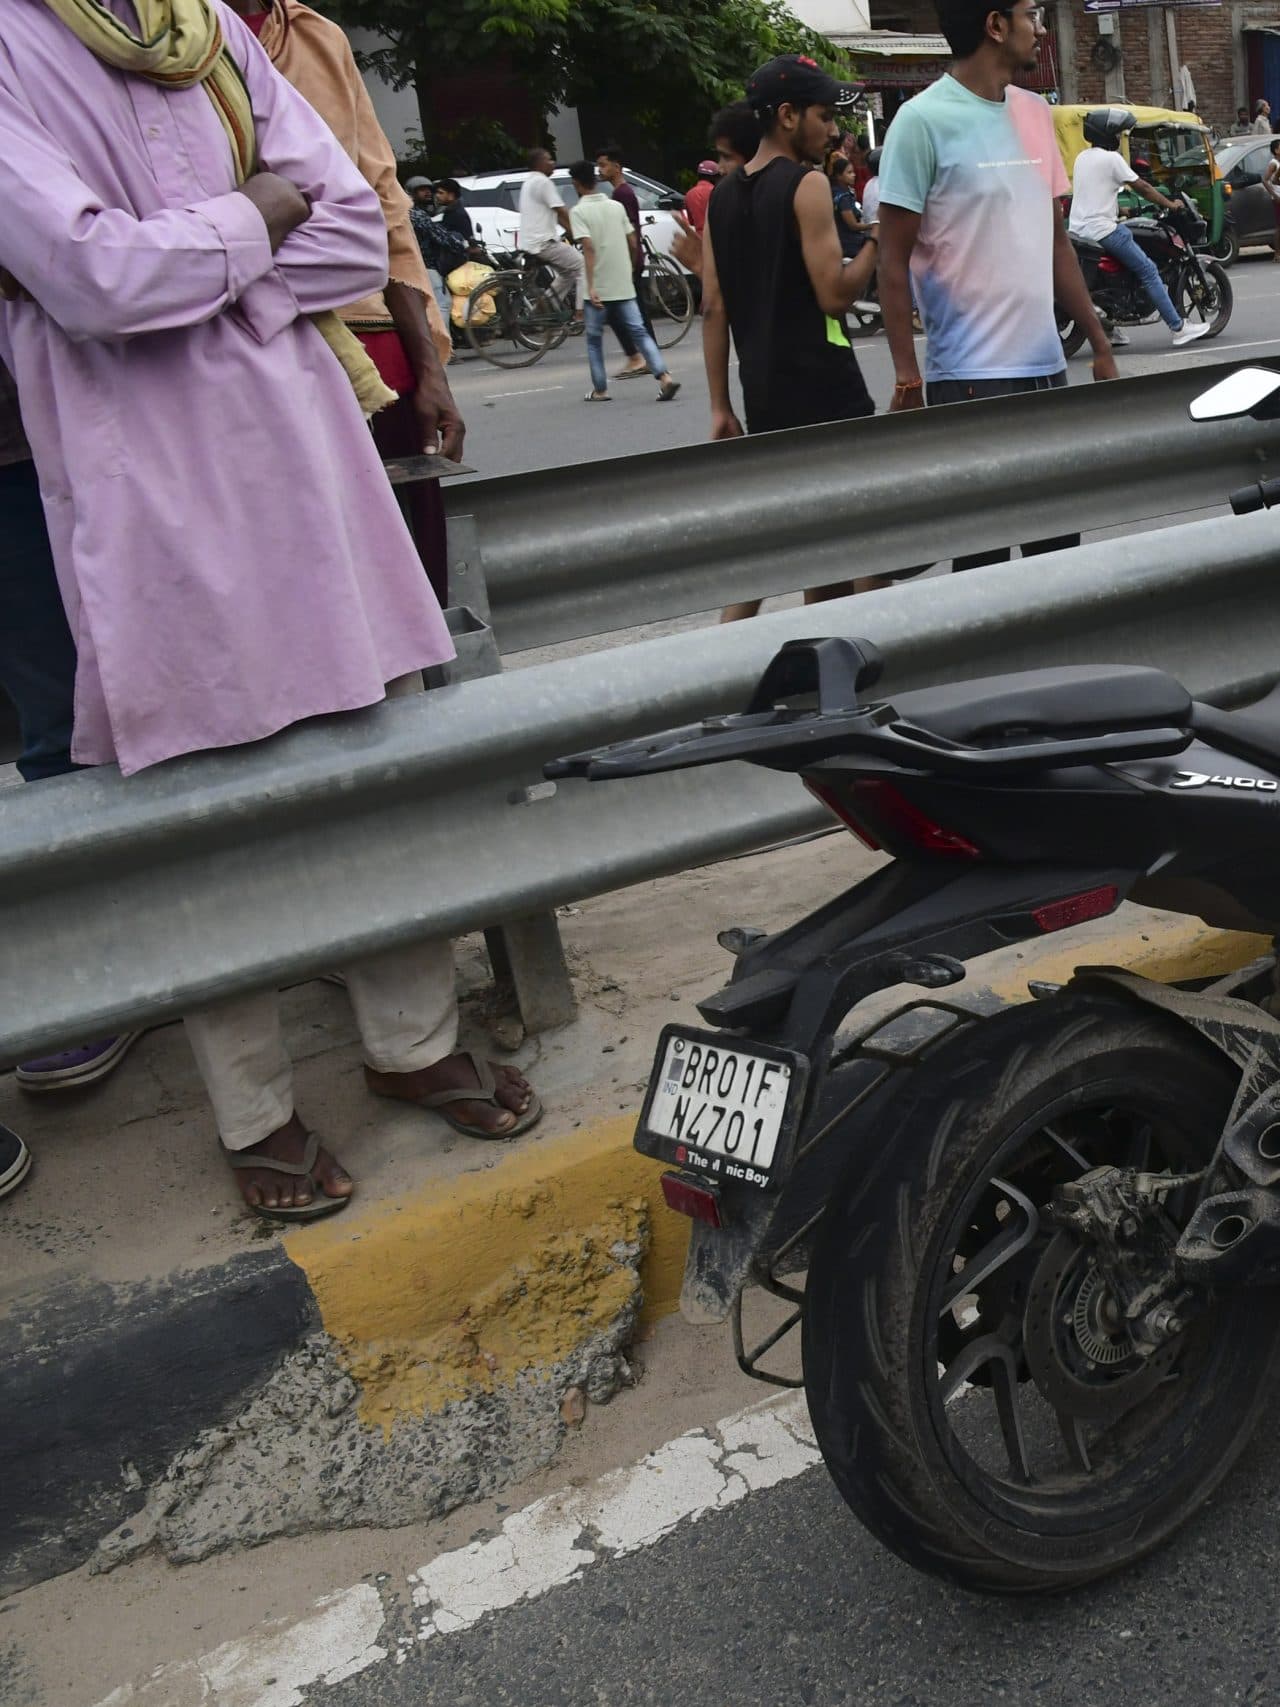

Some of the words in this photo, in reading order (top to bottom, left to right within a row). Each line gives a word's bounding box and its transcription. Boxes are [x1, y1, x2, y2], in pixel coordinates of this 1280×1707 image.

[682, 1045, 781, 1109] BR01F
[669, 1095, 765, 1162] N4701
[687, 1150, 708, 1167] The
[745, 1167, 769, 1187] Boy
